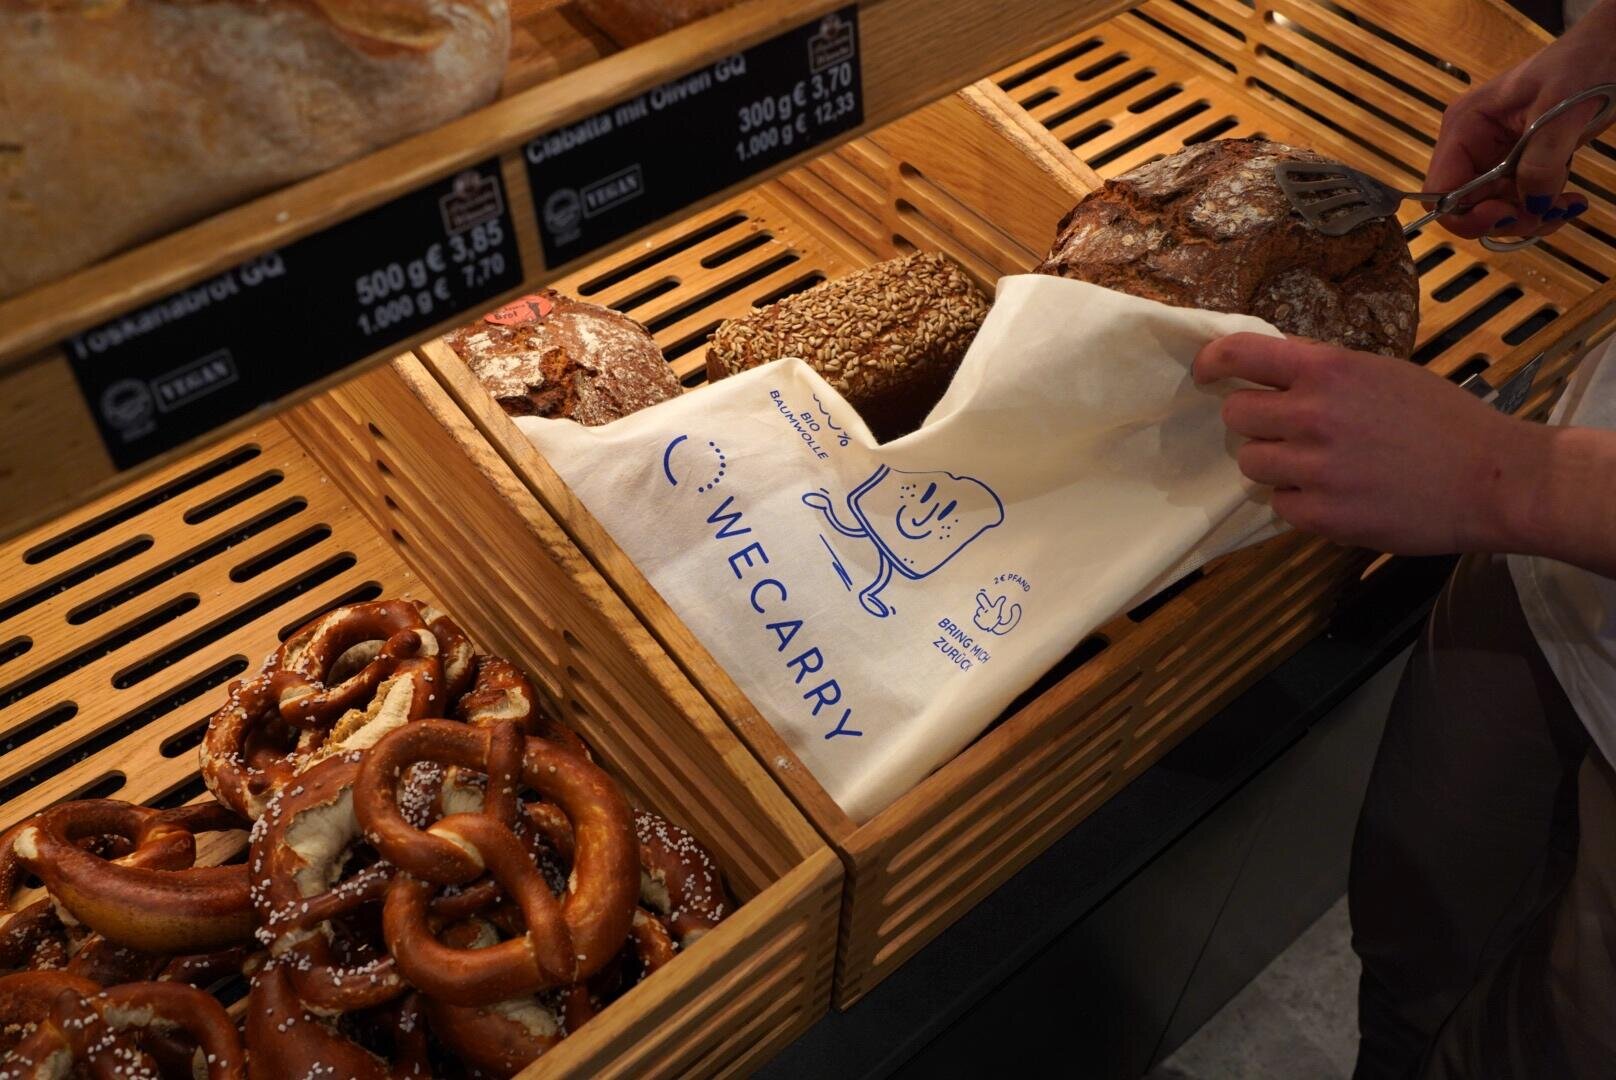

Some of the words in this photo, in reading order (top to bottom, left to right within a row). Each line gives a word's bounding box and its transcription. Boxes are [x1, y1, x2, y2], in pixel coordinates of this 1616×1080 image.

[714, 54, 747, 83] GQ
[738, 96, 776, 133] 300
[777, 97, 792, 121] g
[793, 82, 807, 106] €
[811, 61, 852, 100] 3,70
[736, 130, 779, 162] 1.000
[780, 126, 794, 146] g
[795, 114, 807, 134] €
[813, 91, 856, 127] 12,33
[356, 261, 405, 305] 500
[407, 258, 427, 289] g
[425, 244, 446, 272] €
[447, 220, 503, 264] 3,85
[357, 296, 414, 336] 1.000
[416, 290, 434, 315] g
[433, 279, 450, 300] €
[463, 252, 506, 289] 7,70
[770, 390, 829, 460] BAUMWOLLE
[800, 412, 820, 432] BIO
[1008, 573, 1031, 592] PFAND
[706, 496, 863, 740] WECARRY
[938, 618, 973, 649] BRING
[970, 644, 991, 664] MICH
[932, 636, 973, 672] ZURÜCK
